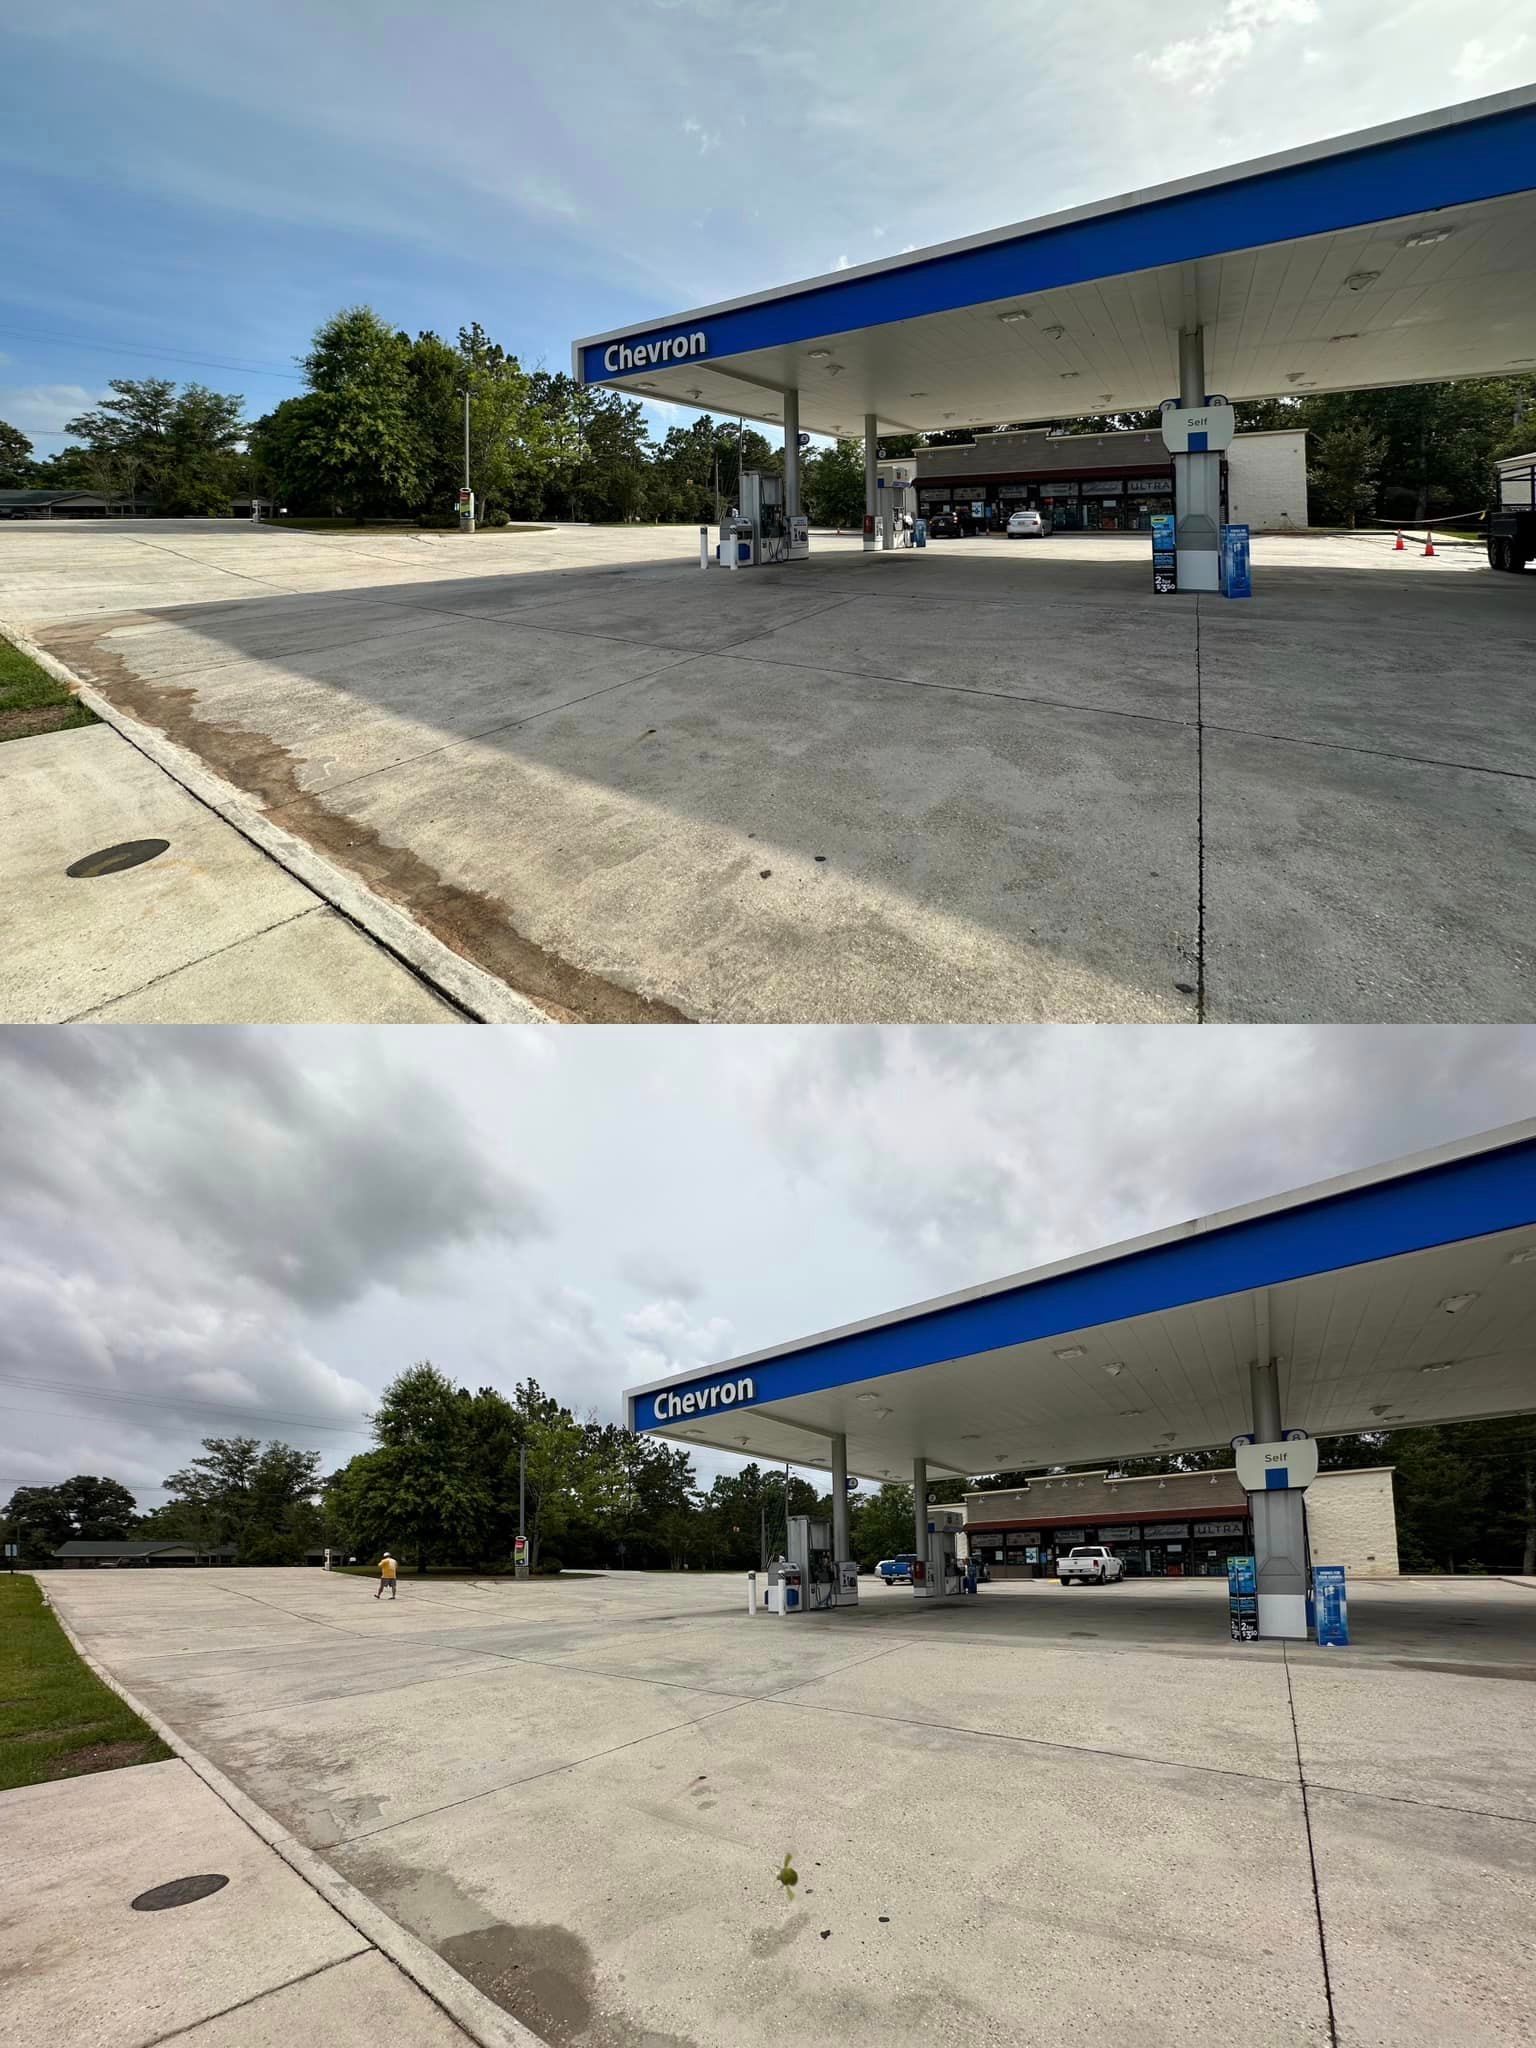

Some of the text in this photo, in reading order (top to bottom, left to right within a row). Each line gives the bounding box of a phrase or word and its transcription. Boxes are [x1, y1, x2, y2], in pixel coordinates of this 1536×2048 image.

[604, 331, 706, 372] Chevron
[1187, 417, 1208, 427] Self
[1130, 480, 1170, 491] ULTRA
[1155, 576, 1162, 584] 2
[654, 1377, 754, 1420] Chevron
[1264, 1453, 1288, 1463] Self
[1198, 1523, 1241, 1535] ULTRA
[1241, 1622, 1247, 1631] 2
